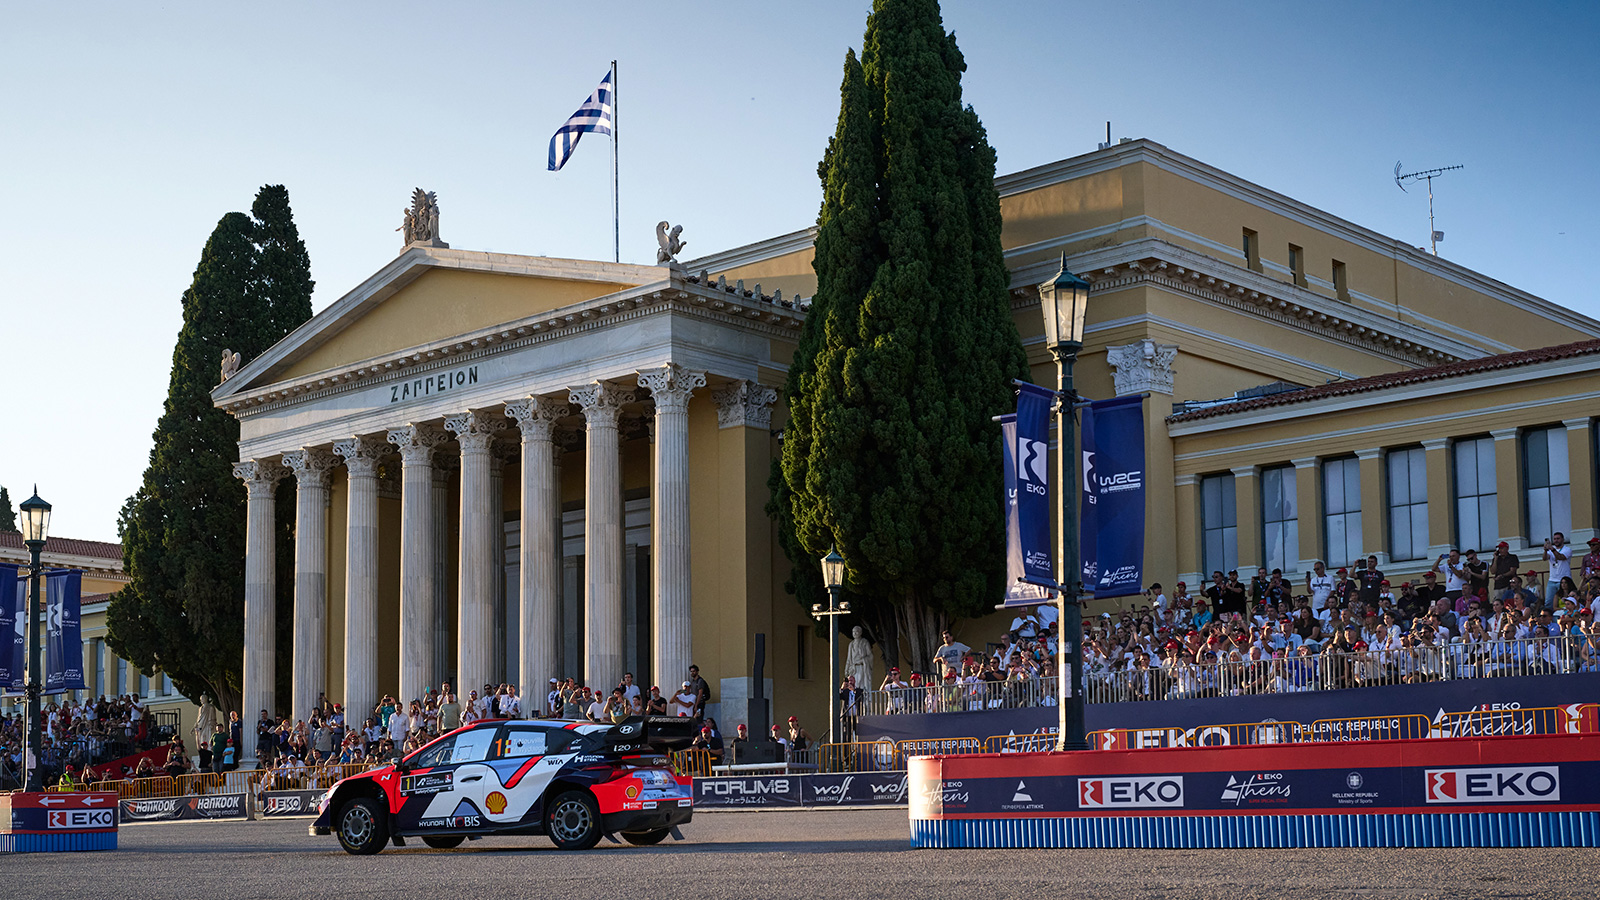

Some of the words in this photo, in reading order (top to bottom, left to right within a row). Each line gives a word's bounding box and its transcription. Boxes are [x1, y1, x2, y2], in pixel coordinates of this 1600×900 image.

[1100, 471, 1140, 486] WRC
[1026, 483, 1046, 496] EKO
[1492, 702, 1520, 710] EKO
[1294, 722, 1344, 734] HELLENIC
[1346, 720, 1400, 731] REPUBLIC
[1136, 726, 1230, 749] EKO
[495, 738, 502, 756] 1
[903, 741, 939, 750] HELLENIC
[942, 740, 980, 749] REPUBLIC
[406, 778, 410, 790] 1
[702, 780, 790, 795] FORUM8
[1221, 774, 1290, 806] Athens
[1466, 771, 1556, 796] EKO
[1110, 780, 1181, 802] EKO
[278, 798, 300, 808] EKO
[72, 811, 112, 825] EKO
[446, 816, 480, 828] MOBIS
